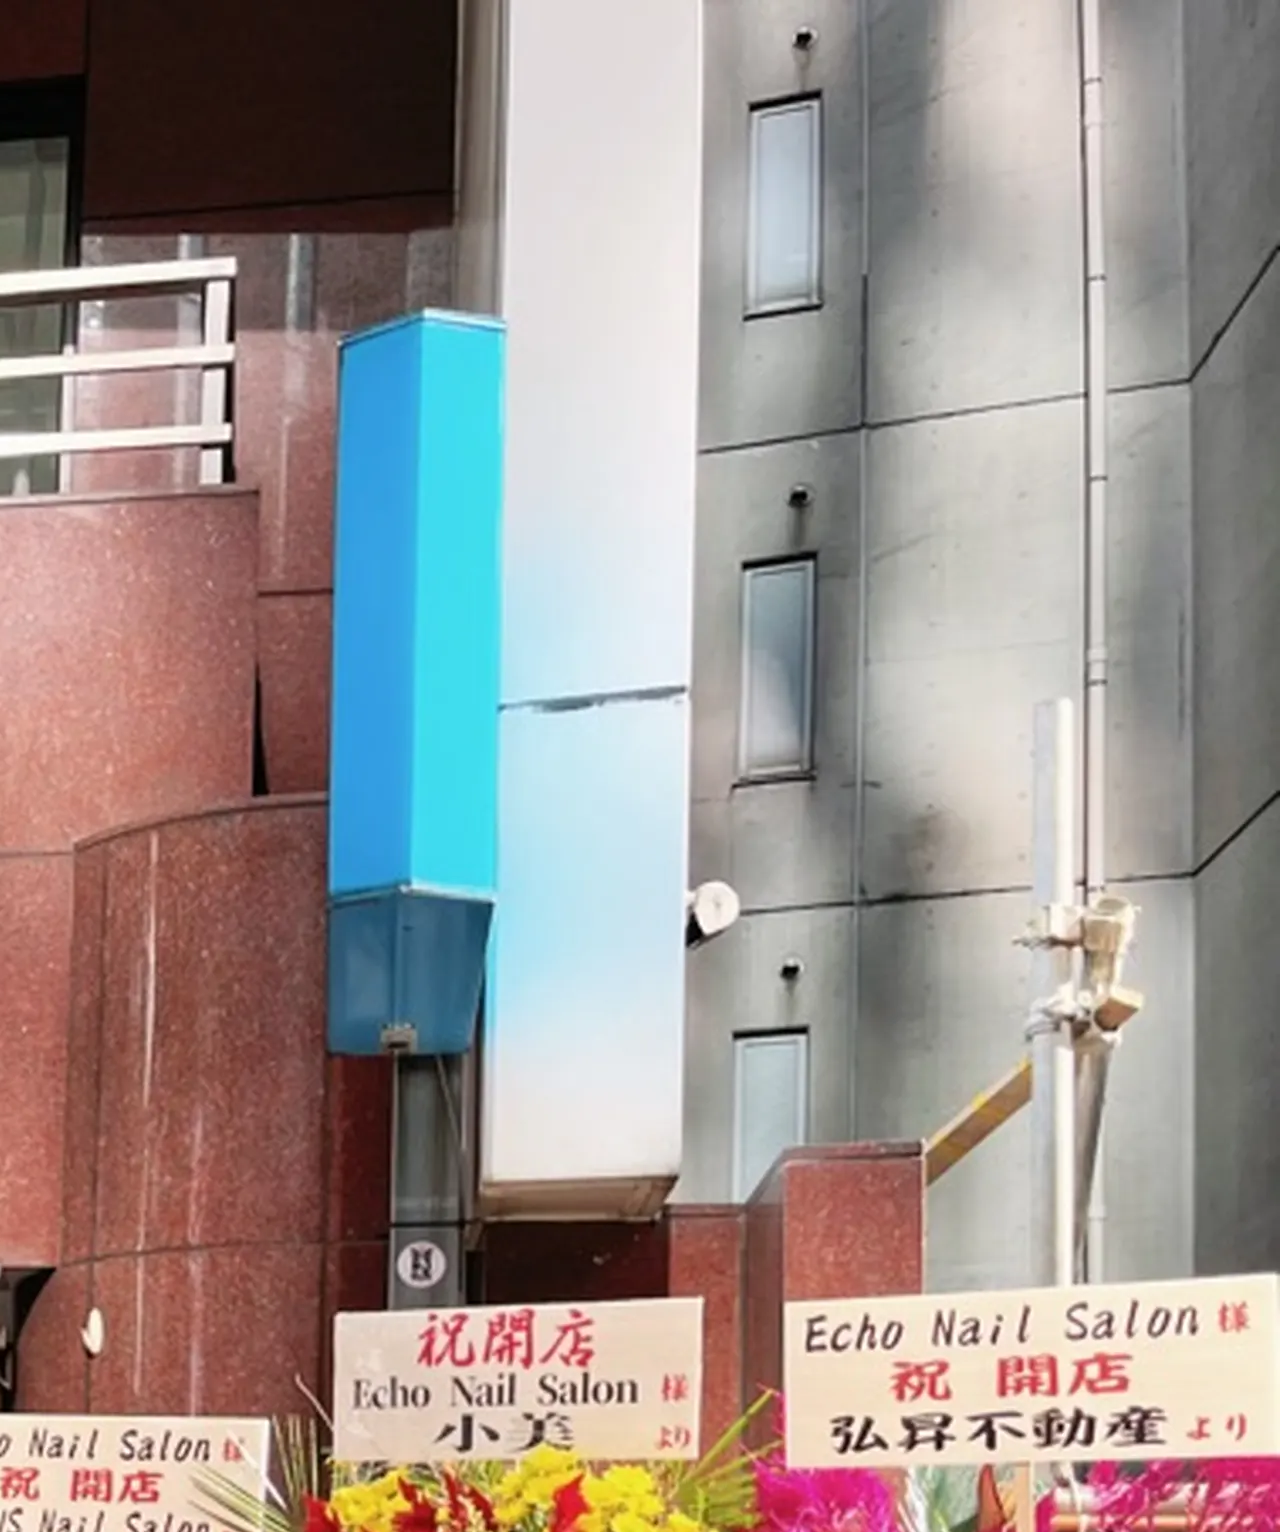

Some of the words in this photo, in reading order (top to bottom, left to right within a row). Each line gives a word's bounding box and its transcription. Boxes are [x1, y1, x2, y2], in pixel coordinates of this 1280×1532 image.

[415, 1308, 596, 1370] 祝開店
[804, 1314, 904, 1353] Echo
[931, 1305, 1032, 1348] Nail
[1065, 1299, 1200, 1342] Salon
[1217, 1302, 1252, 1335] 様
[352, 1375, 432, 1411] Echo
[450, 1373, 517, 1406] Nail
[537, 1370, 639, 1405] Salon
[660, 1372, 688, 1402] 様
[888, 1360, 952, 1402] 祝
[995, 1353, 1134, 1398] 開店
[27, 1427, 100, 1460] Nail
[118, 1429, 211, 1463] Salon
[655, 1425, 692, 1449] より
[1185, 1413, 1248, 1441] より
[0, 1466, 41, 1501] 祝
[69, 1468, 164, 1503] 開店
